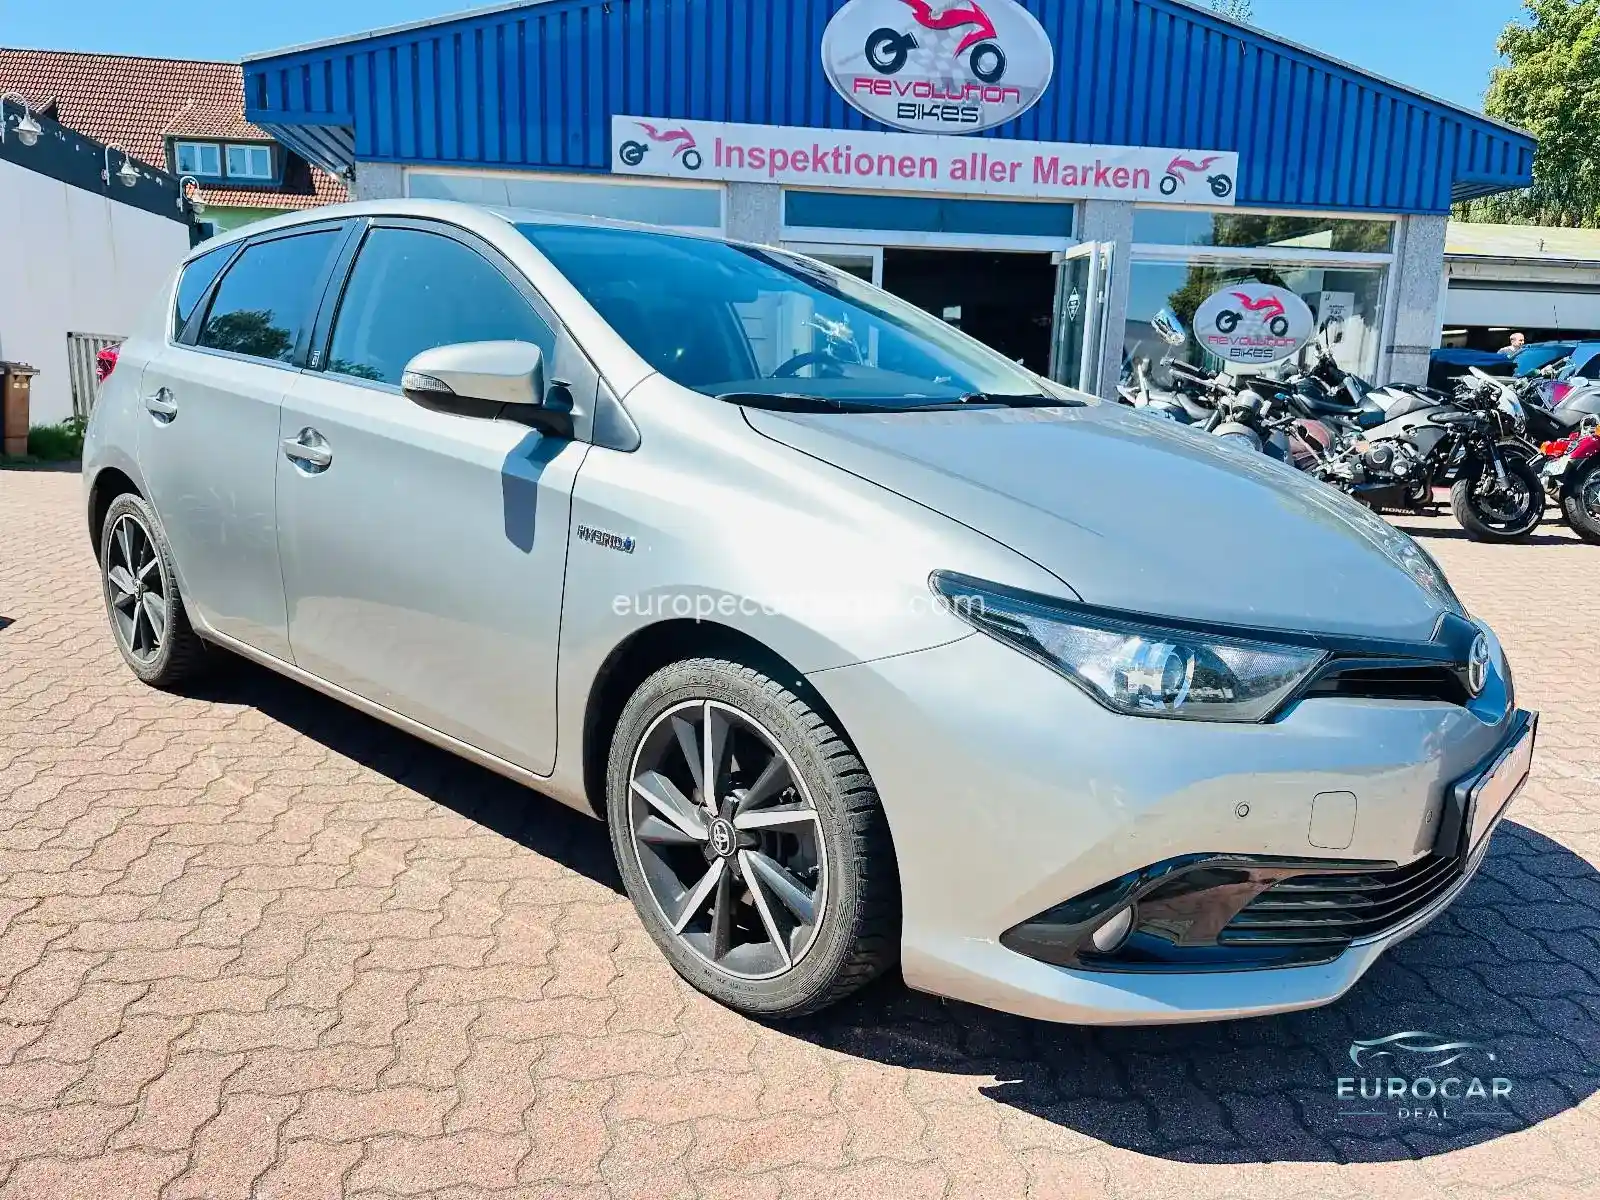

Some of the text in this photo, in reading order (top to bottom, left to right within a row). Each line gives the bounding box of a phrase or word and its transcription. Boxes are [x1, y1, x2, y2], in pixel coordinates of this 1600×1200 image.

[713, 137, 1150, 190] Inspektionen aller Marken
[1380, 506, 1416, 515] HONDA
